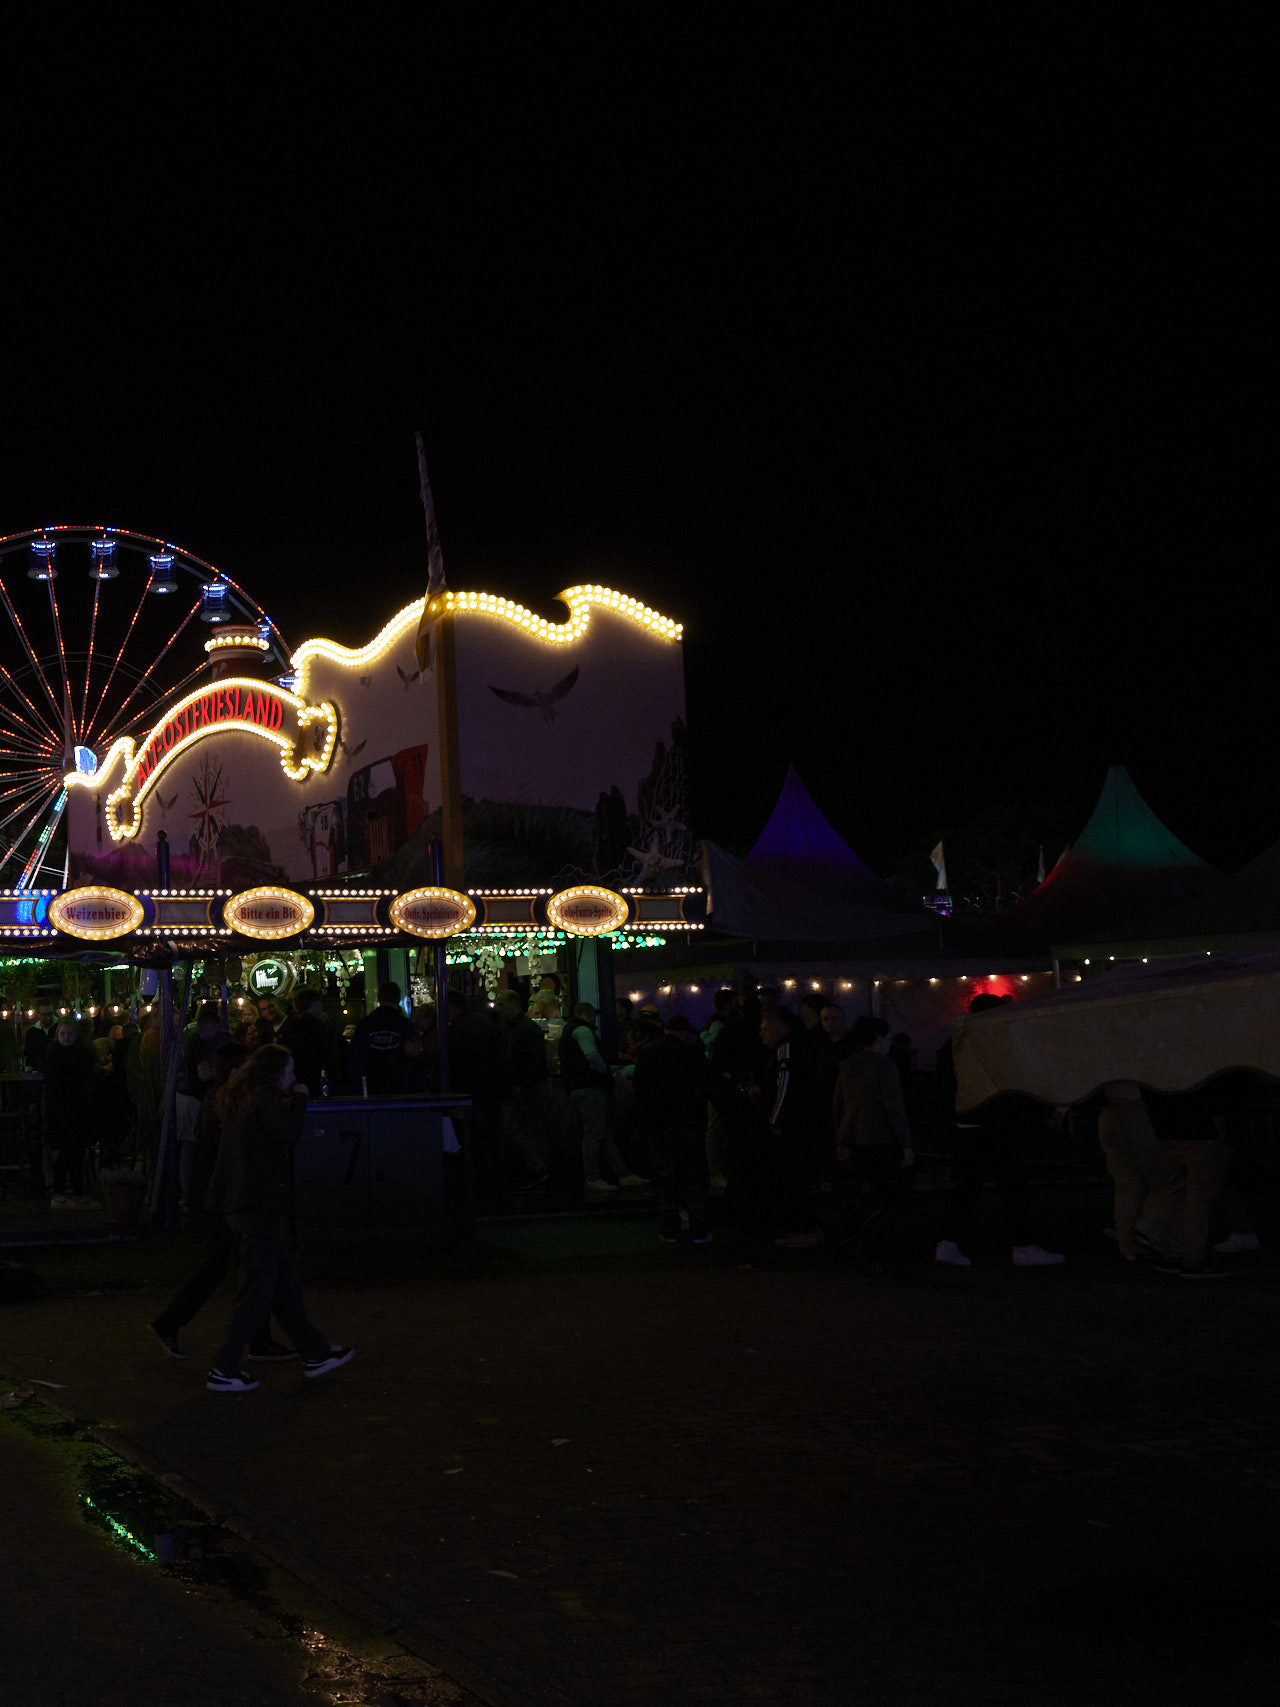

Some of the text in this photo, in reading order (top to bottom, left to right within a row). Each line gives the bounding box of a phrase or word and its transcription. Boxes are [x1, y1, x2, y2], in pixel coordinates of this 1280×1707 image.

[137, 687, 283, 792] ALT-OSTFRIESLAND
[66, 906, 126, 920] Weizenbier
[240, 907, 296, 920] Bitte ein Bit
